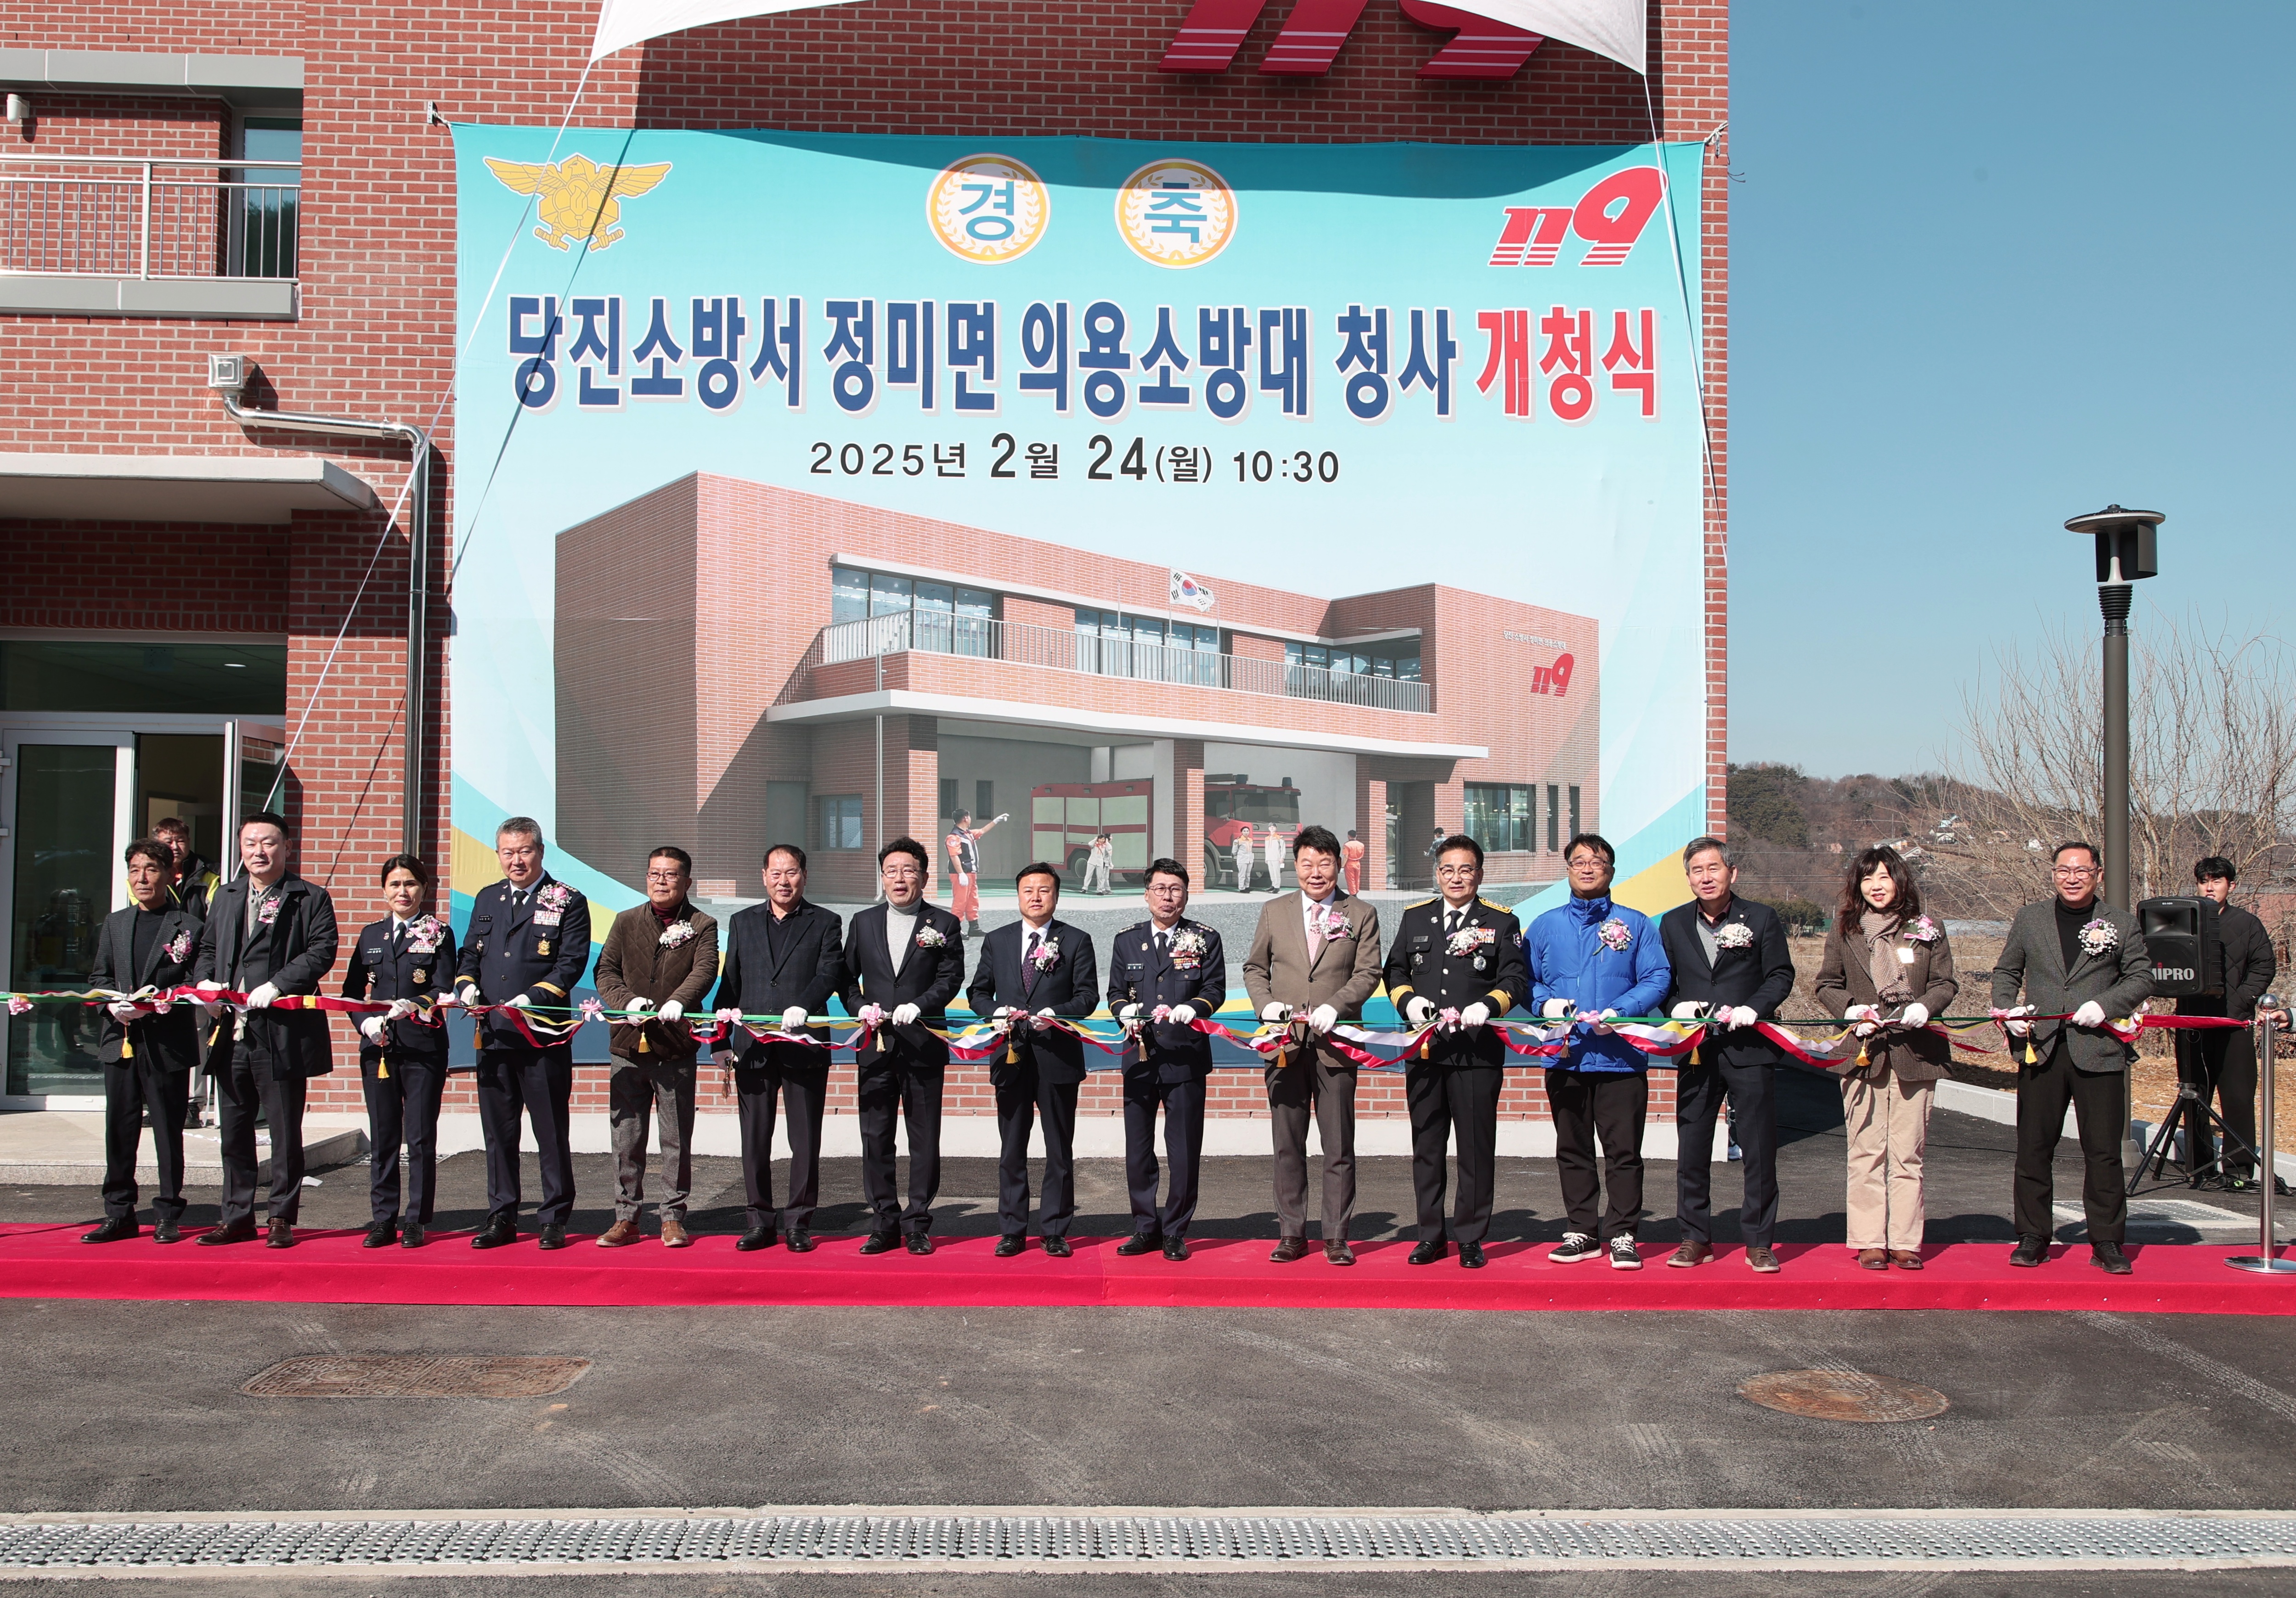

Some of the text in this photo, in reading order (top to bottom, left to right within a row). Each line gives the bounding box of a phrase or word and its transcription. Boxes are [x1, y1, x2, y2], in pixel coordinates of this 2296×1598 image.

[959, 181, 1207, 243] 경 축
[1490, 167, 1666, 266] 119
[509, 296, 1655, 421] 당진소방서 정미면 의용소방대 청사 개청식
[810, 432, 1339, 484] 2025년 2월 24(월) 10:30
[1503, 630, 1513, 640] 당진
[1514, 633, 1529, 643] 소방서
[1530, 653, 1574, 697] 119
